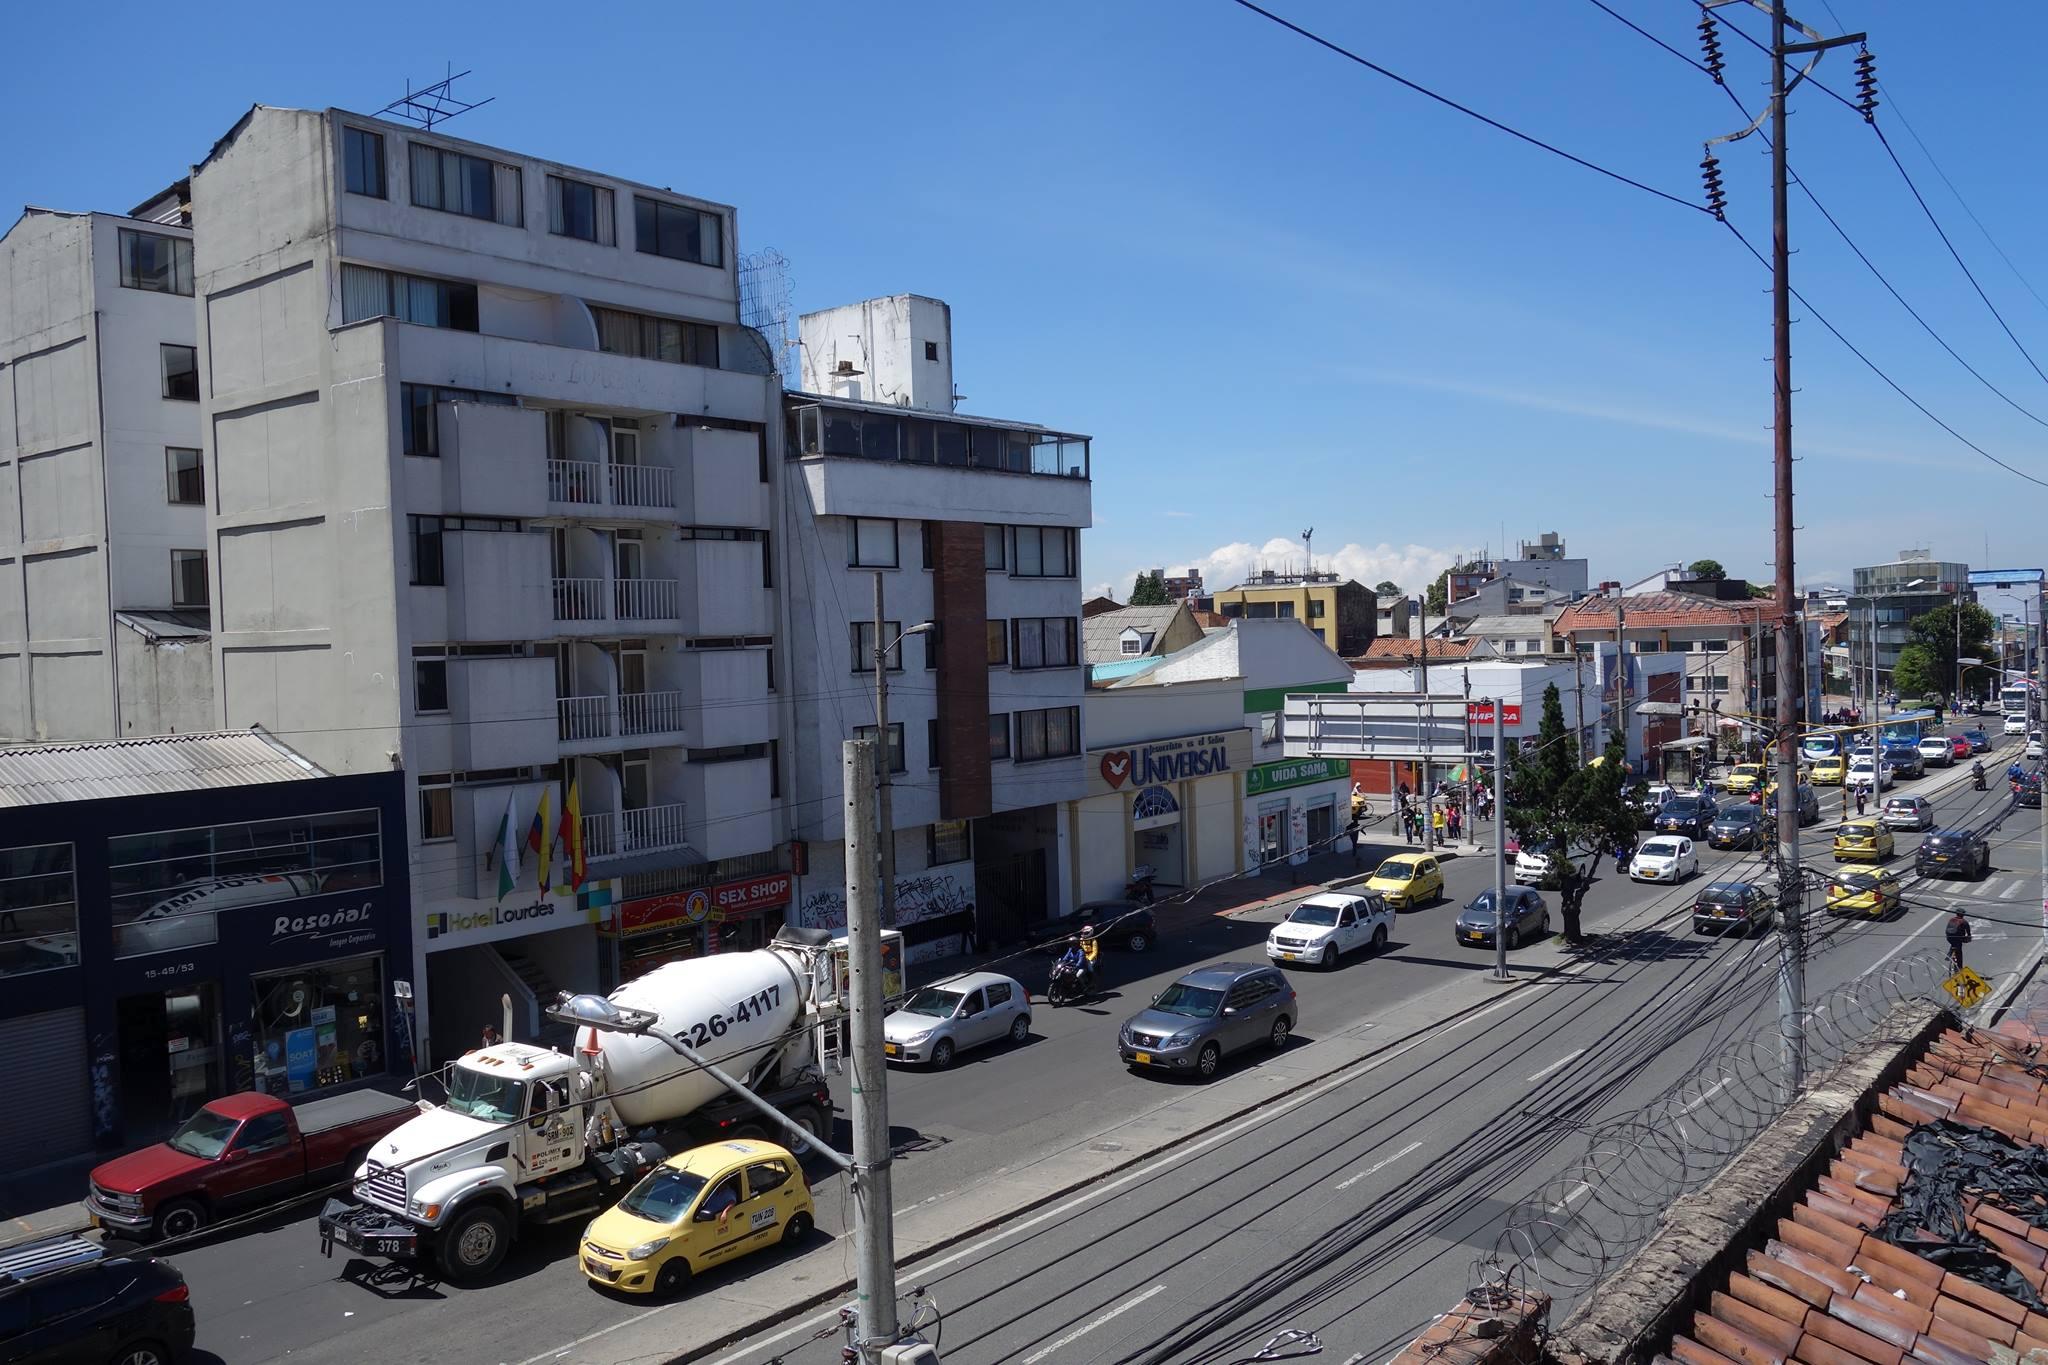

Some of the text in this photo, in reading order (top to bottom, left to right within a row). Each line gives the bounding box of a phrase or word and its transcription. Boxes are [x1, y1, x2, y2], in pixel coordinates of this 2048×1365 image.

[1198, 736, 1205, 746] el
[1130, 746, 1231, 787] UNIVERSAL
[1271, 767, 1298, 783] VIDA
[719, 887, 747, 905] SEX
[750, 879, 788, 898] SHOP
[449, 900, 555, 932] Hotel Lourdes
[673, 983, 780, 1055] 626-4117
[377, 1240, 400, 1253] 378
